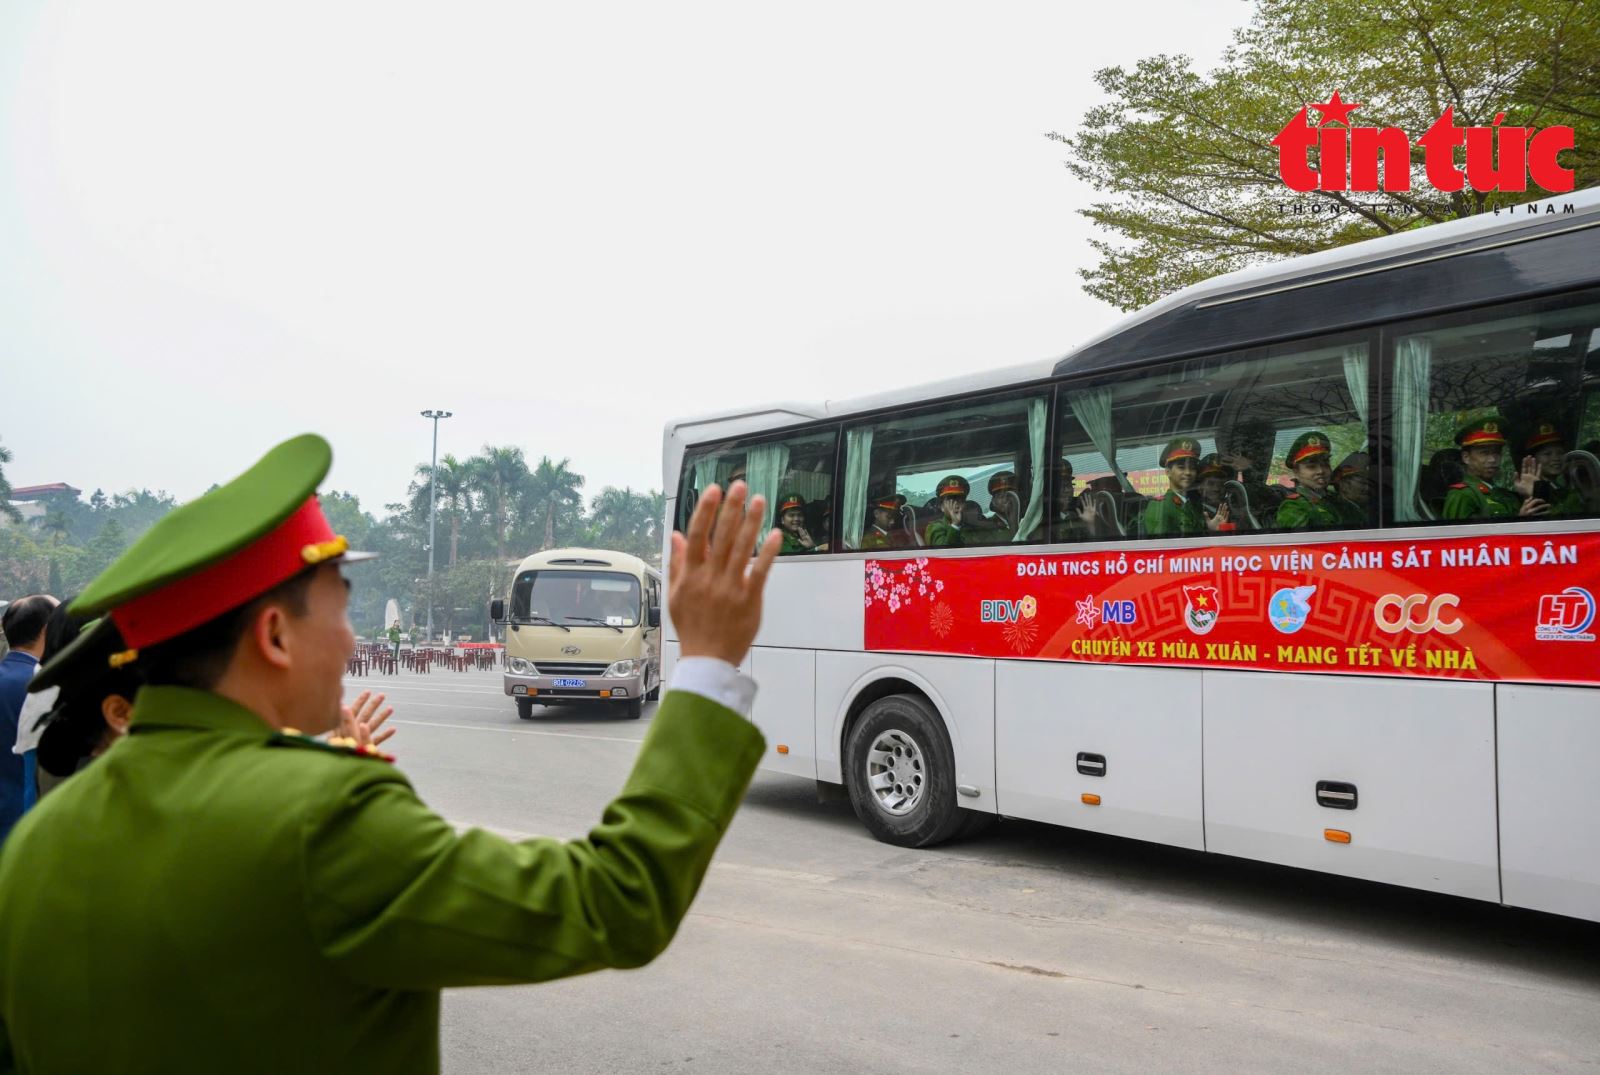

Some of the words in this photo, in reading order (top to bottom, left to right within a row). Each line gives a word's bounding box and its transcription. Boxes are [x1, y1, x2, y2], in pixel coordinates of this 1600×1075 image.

[1016, 558, 1057, 576] ĐOÀN
[1062, 560, 1100, 575] TNCS
[1105, 553, 1128, 575] HỒ
[1134, 554, 1165, 574] CHÍ
[1169, 557, 1214, 573] MINH
[1221, 555, 1262, 576] HỌC
[1270, 550, 1313, 575] VIỆN
[1322, 546, 1383, 570] CẢNH
[1391, 545, 1432, 568] SÁT
[1441, 543, 1510, 567] NHÂN
[1520, 540, 1577, 565] DÂN
[981, 599, 1022, 623] BIDV
[1102, 600, 1136, 624] MB
[1071, 636, 1131, 656] CHUYẾN
[1136, 641, 1157, 658] XE
[1162, 639, 1200, 659] MÙA
[1205, 641, 1257, 661] XUÂN
[1277, 645, 1338, 664] MANG
[1345, 642, 1382, 666] TẾT
[1389, 643, 1417, 667] VỀ
[1425, 647, 1477, 669] NHÀ
